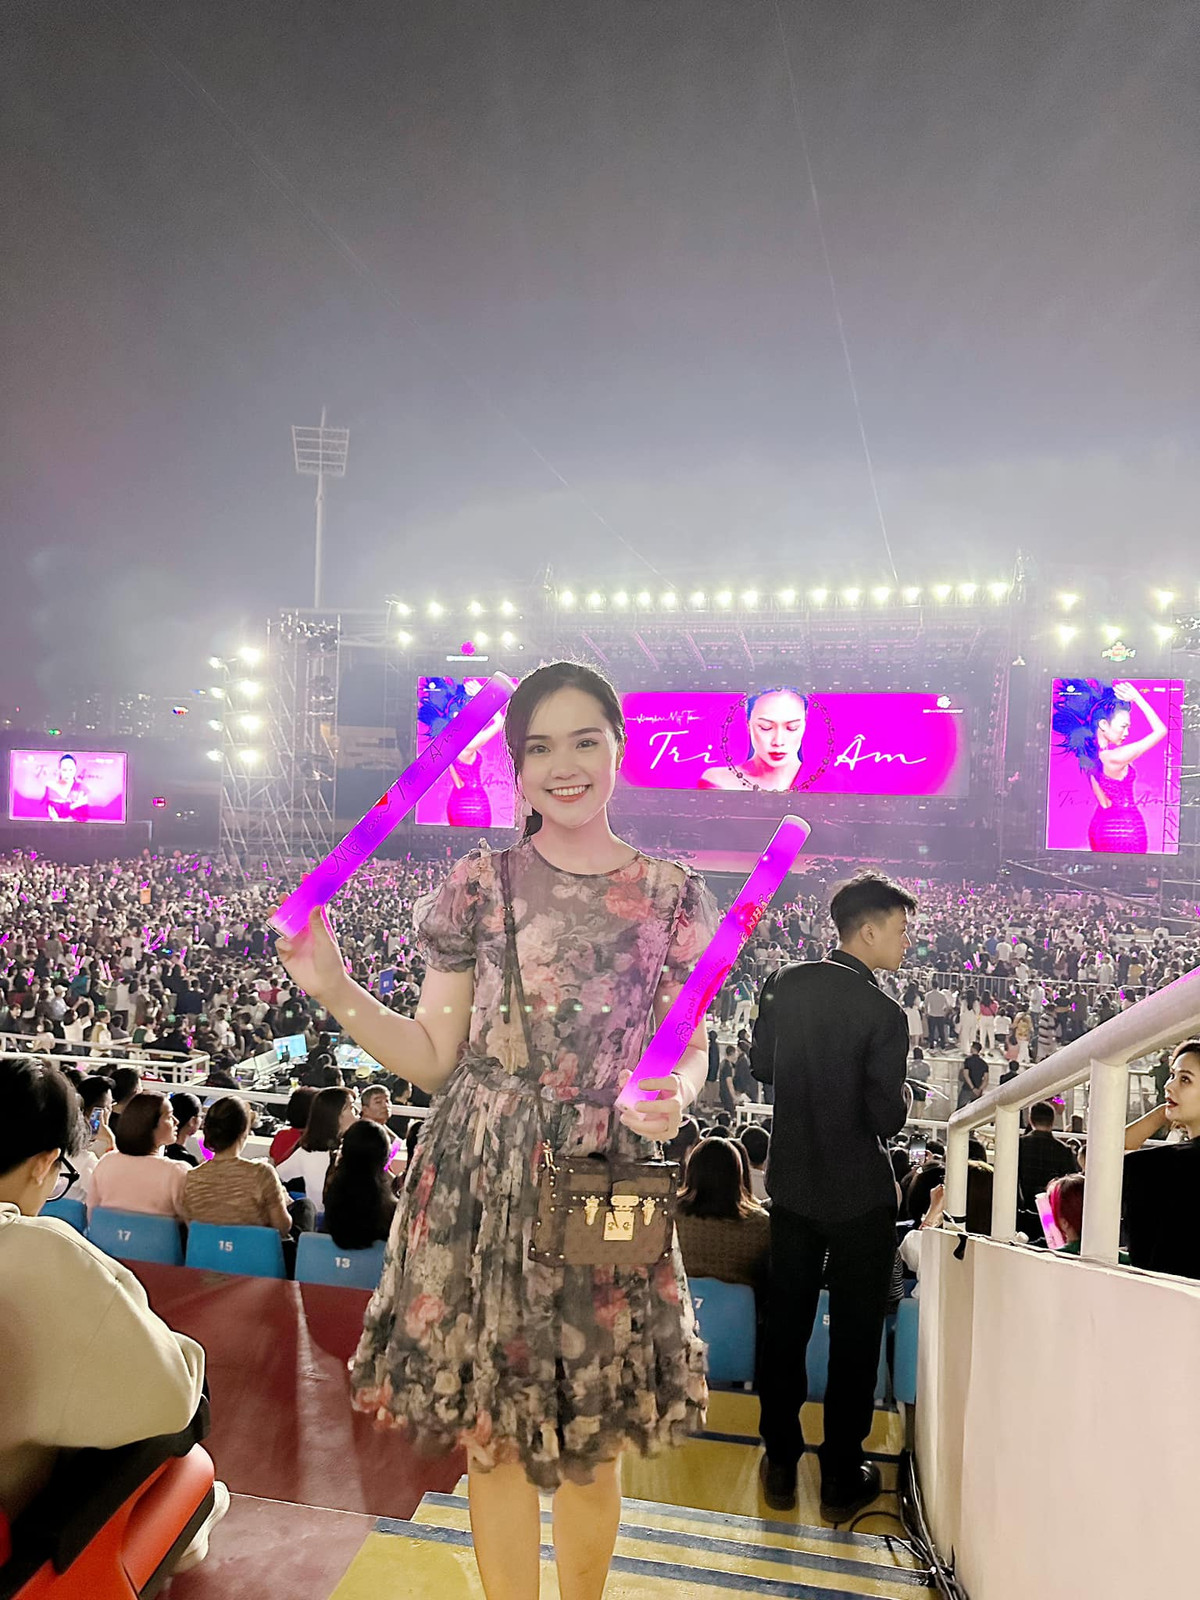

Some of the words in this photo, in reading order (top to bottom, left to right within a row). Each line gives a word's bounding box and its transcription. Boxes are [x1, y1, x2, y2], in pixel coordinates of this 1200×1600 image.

[649, 730, 718, 770] Tri
[834, 734, 927, 771] Âm
[685, 996, 697, 1020] Cook
[117, 1228, 132, 1242] 17
[218, 1240, 233, 1252] 15
[334, 1256, 351, 1269] 13
